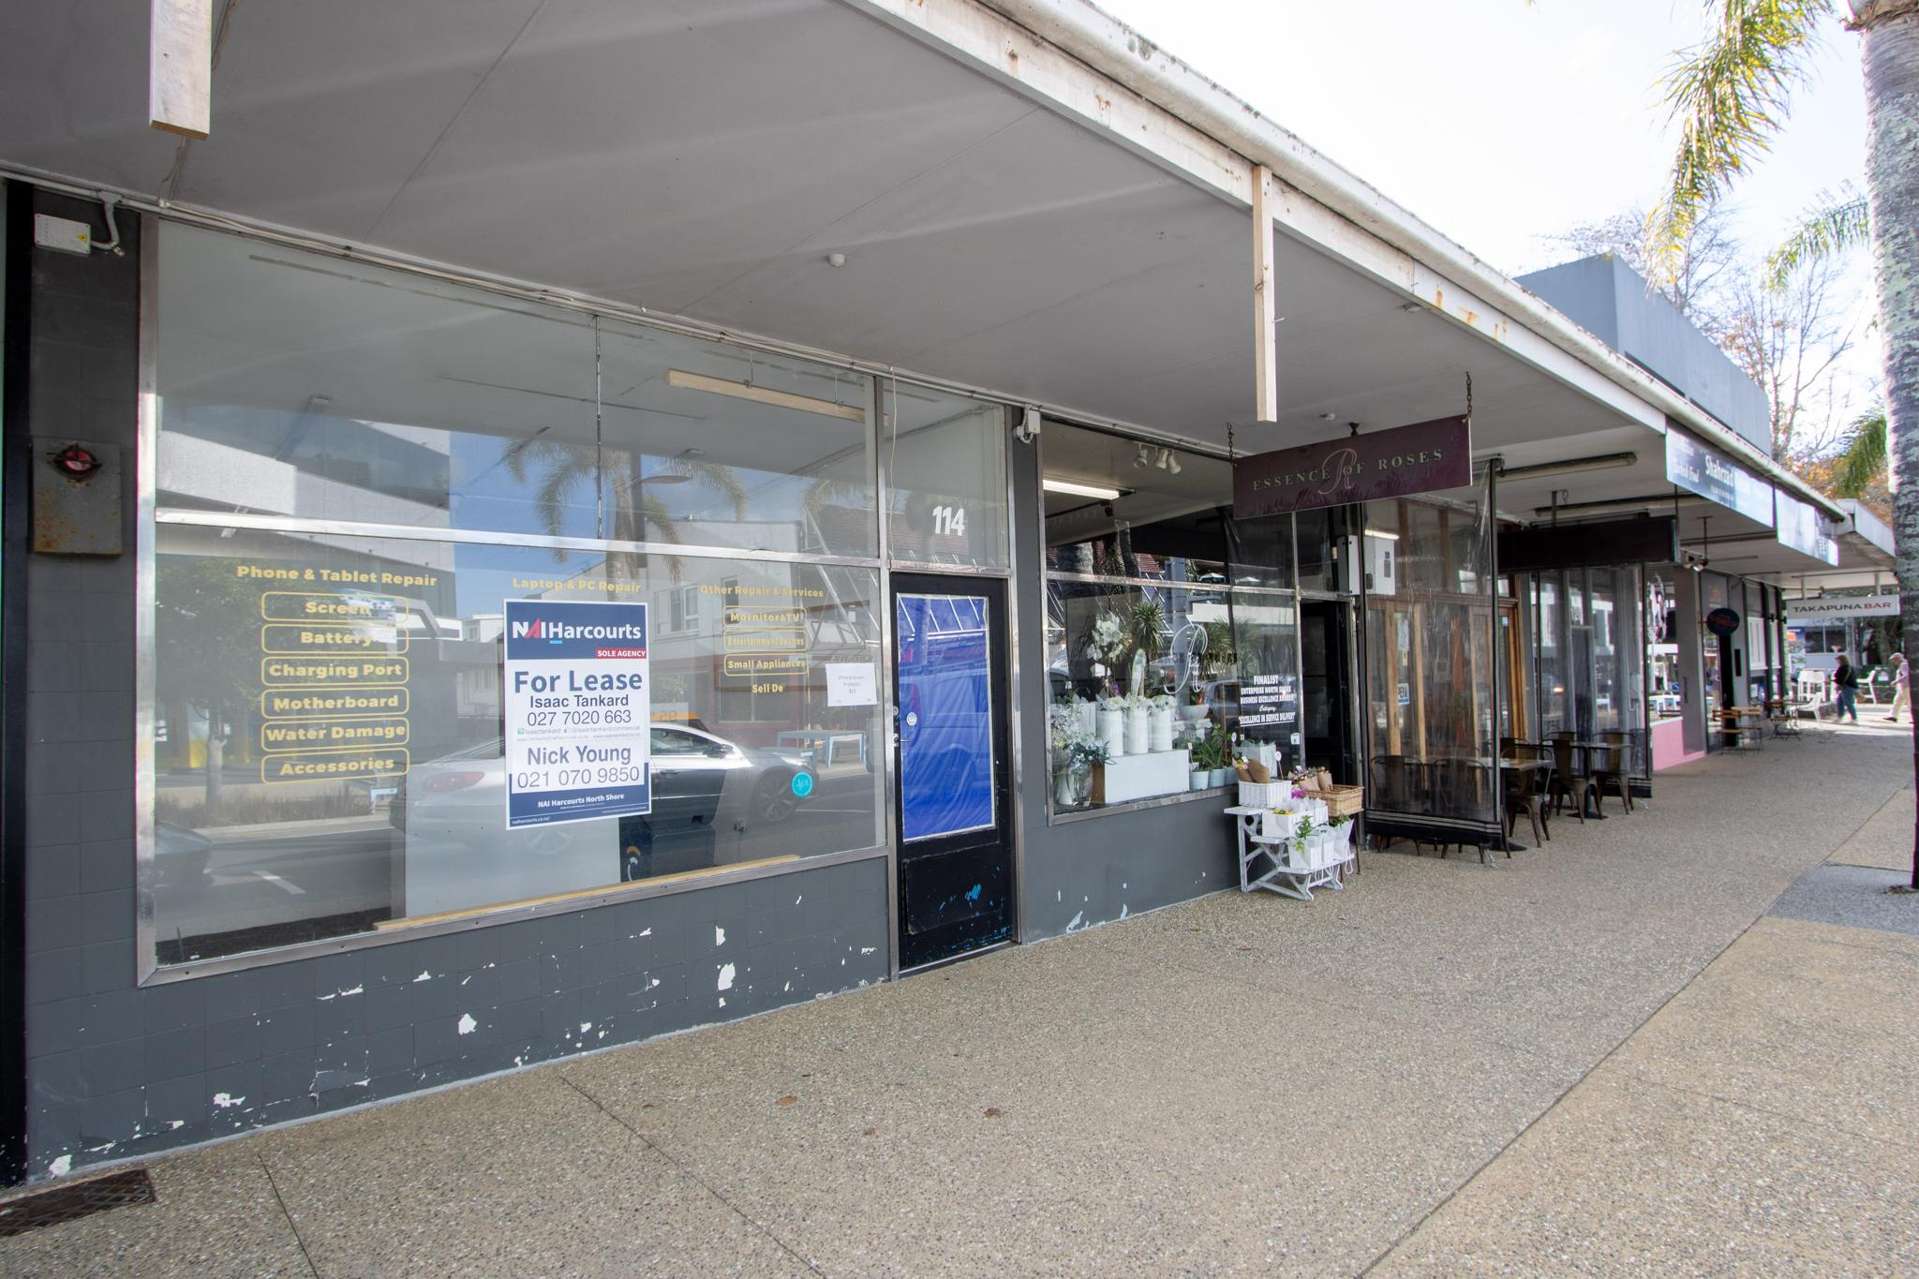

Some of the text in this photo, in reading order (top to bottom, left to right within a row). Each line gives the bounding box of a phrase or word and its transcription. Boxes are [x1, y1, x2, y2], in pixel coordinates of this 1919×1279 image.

[1253, 469, 1330, 490] ESSENCE
[1378, 448, 1442, 470] ROSES
[932, 505, 965, 536] 114
[236, 566, 437, 587] Phone & Tablet Repair
[512, 576, 563, 593] Laptop
[578, 579, 596, 589] PC
[598, 580, 642, 593] Repair
[305, 601, 371, 615] Screen
[1793, 602, 1892, 613] TAKAPUNA BAR
[548, 621, 642, 640] Harcourts
[301, 631, 373, 647] Battery
[617, 649, 647, 657] AGENCY
[269, 664, 402, 679] Charging Port
[727, 659, 754, 669] Small
[514, 670, 643, 693] For Lease
[272, 695, 399, 711] Motherboard
[530, 694, 629, 708] Isaac Tankard
[527, 711, 557, 726] 027
[562, 710, 600, 725] 7020
[604, 709, 632, 724] 663
[266, 726, 406, 741] Water Damage
[527, 745, 631, 765] Nick Young
[279, 758, 395, 775] Accessories
[517, 766, 640, 788] 021 070 9850
[538, 800, 550, 808] NAI
[552, 797, 585, 807] Harcourts
[586, 795, 605, 803] North
[605, 793, 625, 801] Shore
